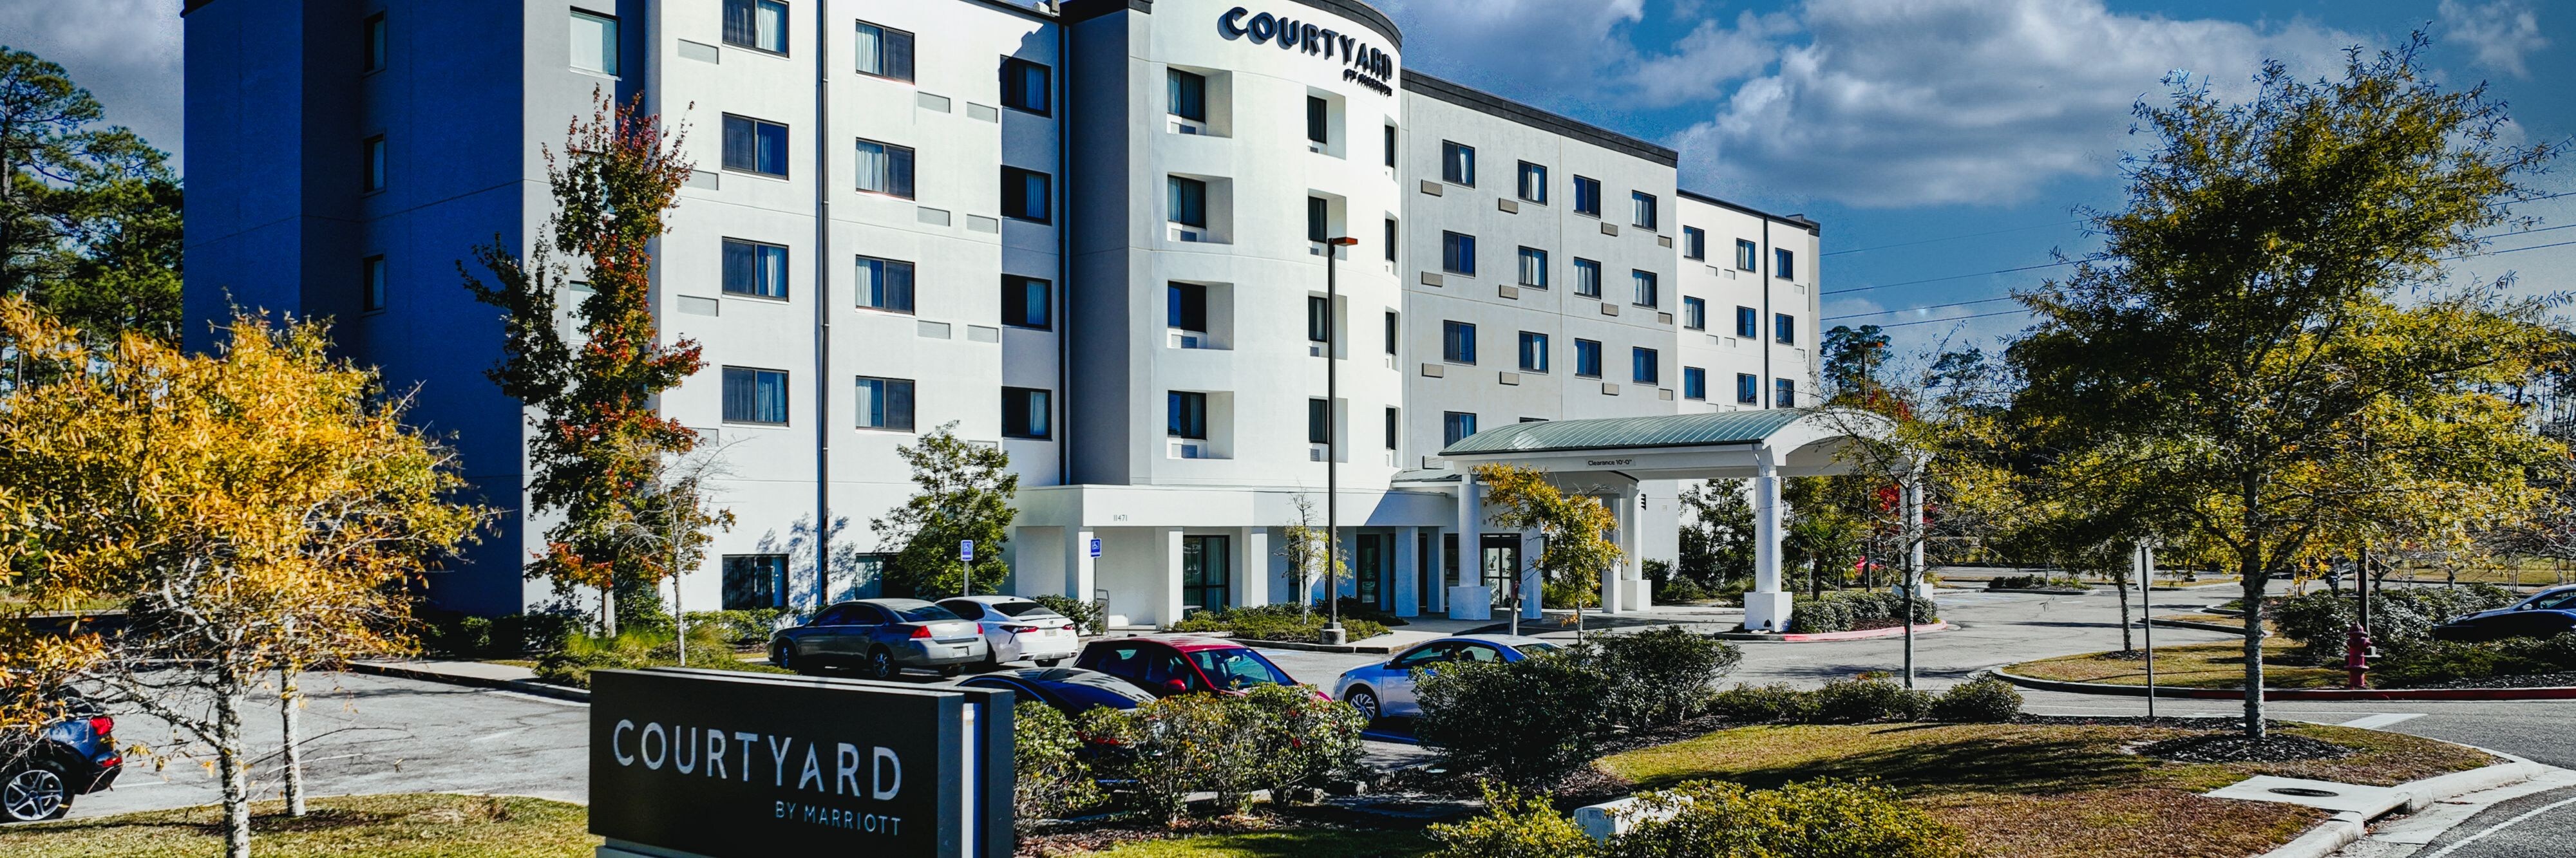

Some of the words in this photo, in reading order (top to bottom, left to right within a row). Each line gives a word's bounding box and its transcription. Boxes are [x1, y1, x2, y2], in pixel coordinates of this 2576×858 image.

[1217, 6, 1393, 81] COURTYARD
[613, 719, 902, 801] COURTYARD
[775, 800, 797, 819] BY
[804, 805, 901, 836] MARRIOTT
